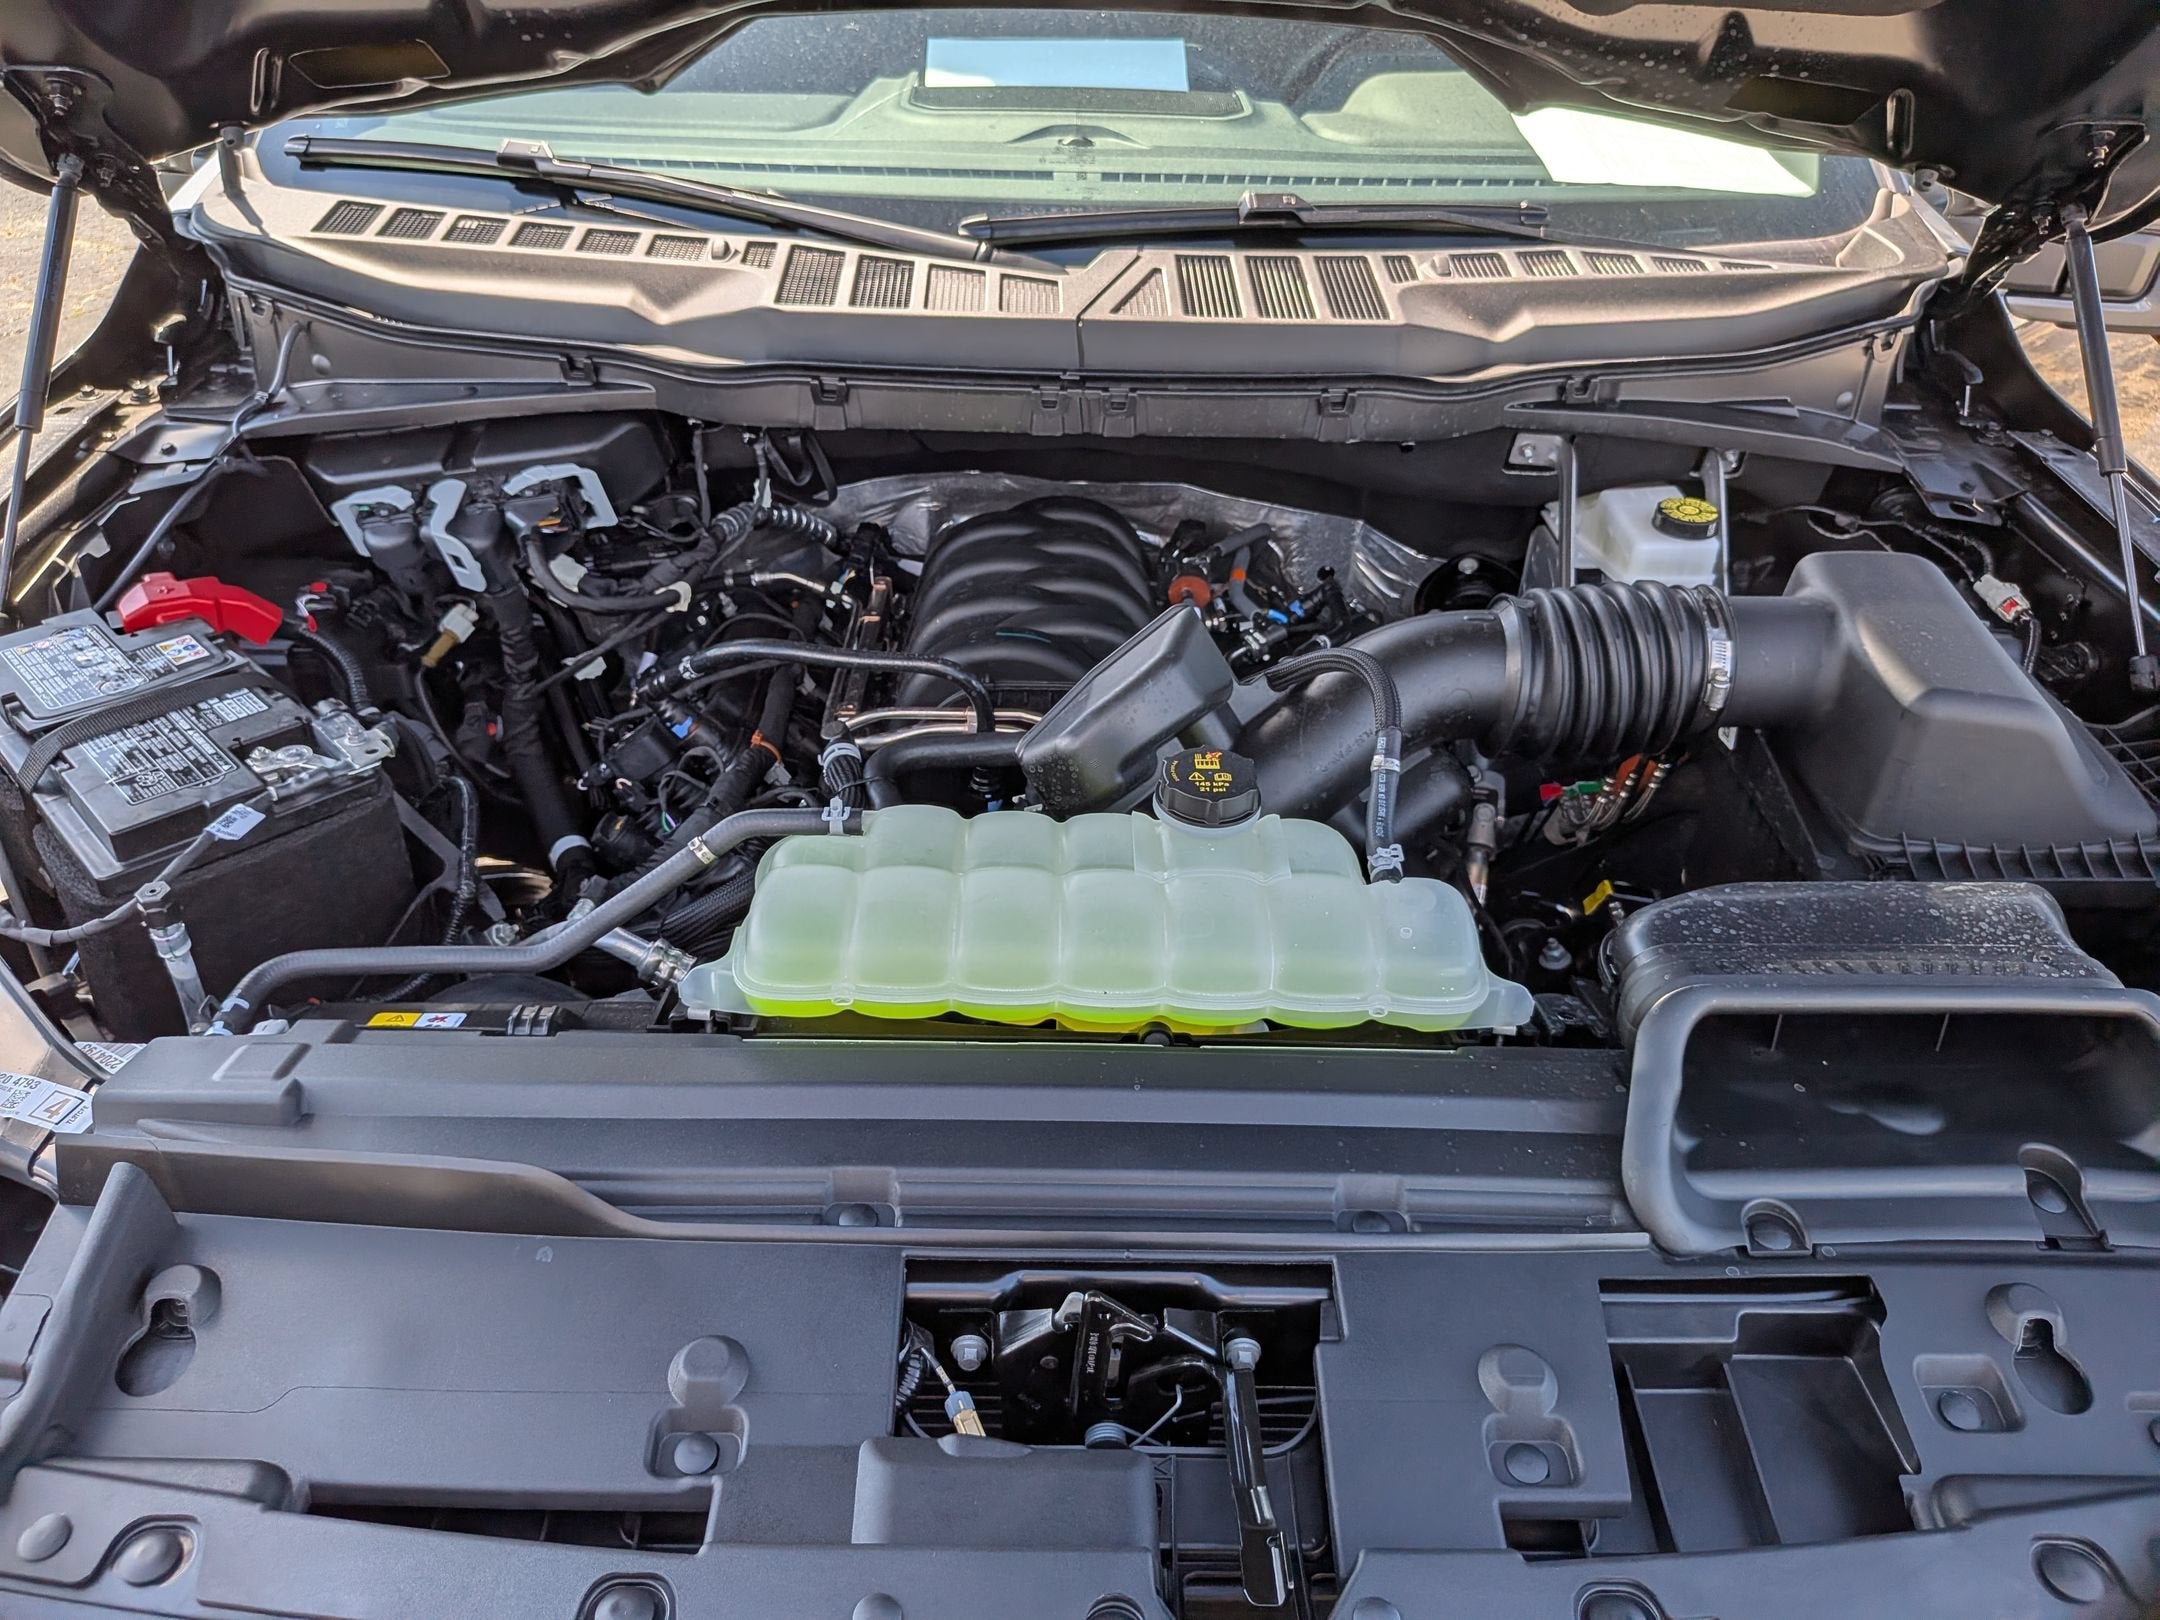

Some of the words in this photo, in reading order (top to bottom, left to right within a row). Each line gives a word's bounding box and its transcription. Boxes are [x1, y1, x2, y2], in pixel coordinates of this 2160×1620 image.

[81, 1044, 125, 1069] 2204793
[13, 1077, 42, 1090] 4793
[43, 1098, 72, 1119] 4
